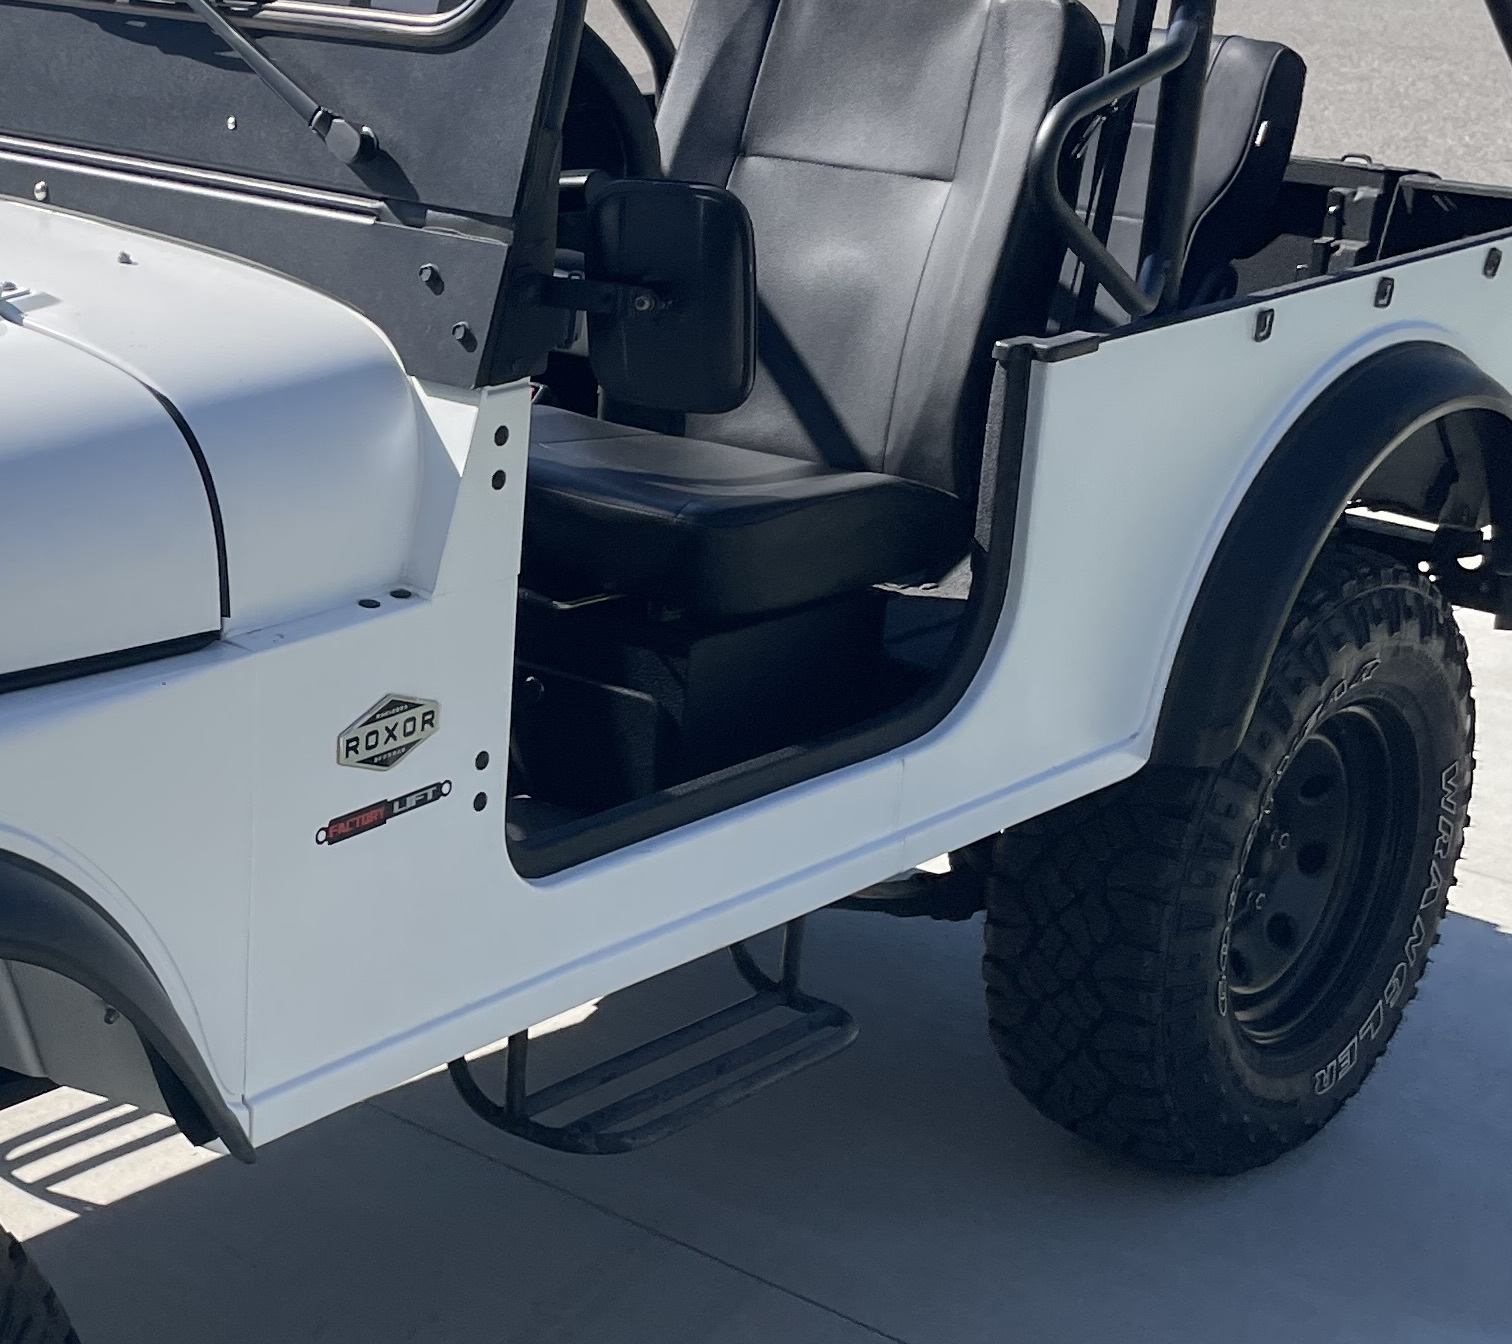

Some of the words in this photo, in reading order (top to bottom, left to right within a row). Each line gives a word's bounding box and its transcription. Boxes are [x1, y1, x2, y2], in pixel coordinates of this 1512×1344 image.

[345, 710, 435, 758] ROXOR
[329, 808, 386, 838] FACTORY
[393, 787, 438, 814] LIFT
[1314, 761, 1458, 1096] WRANGLER
